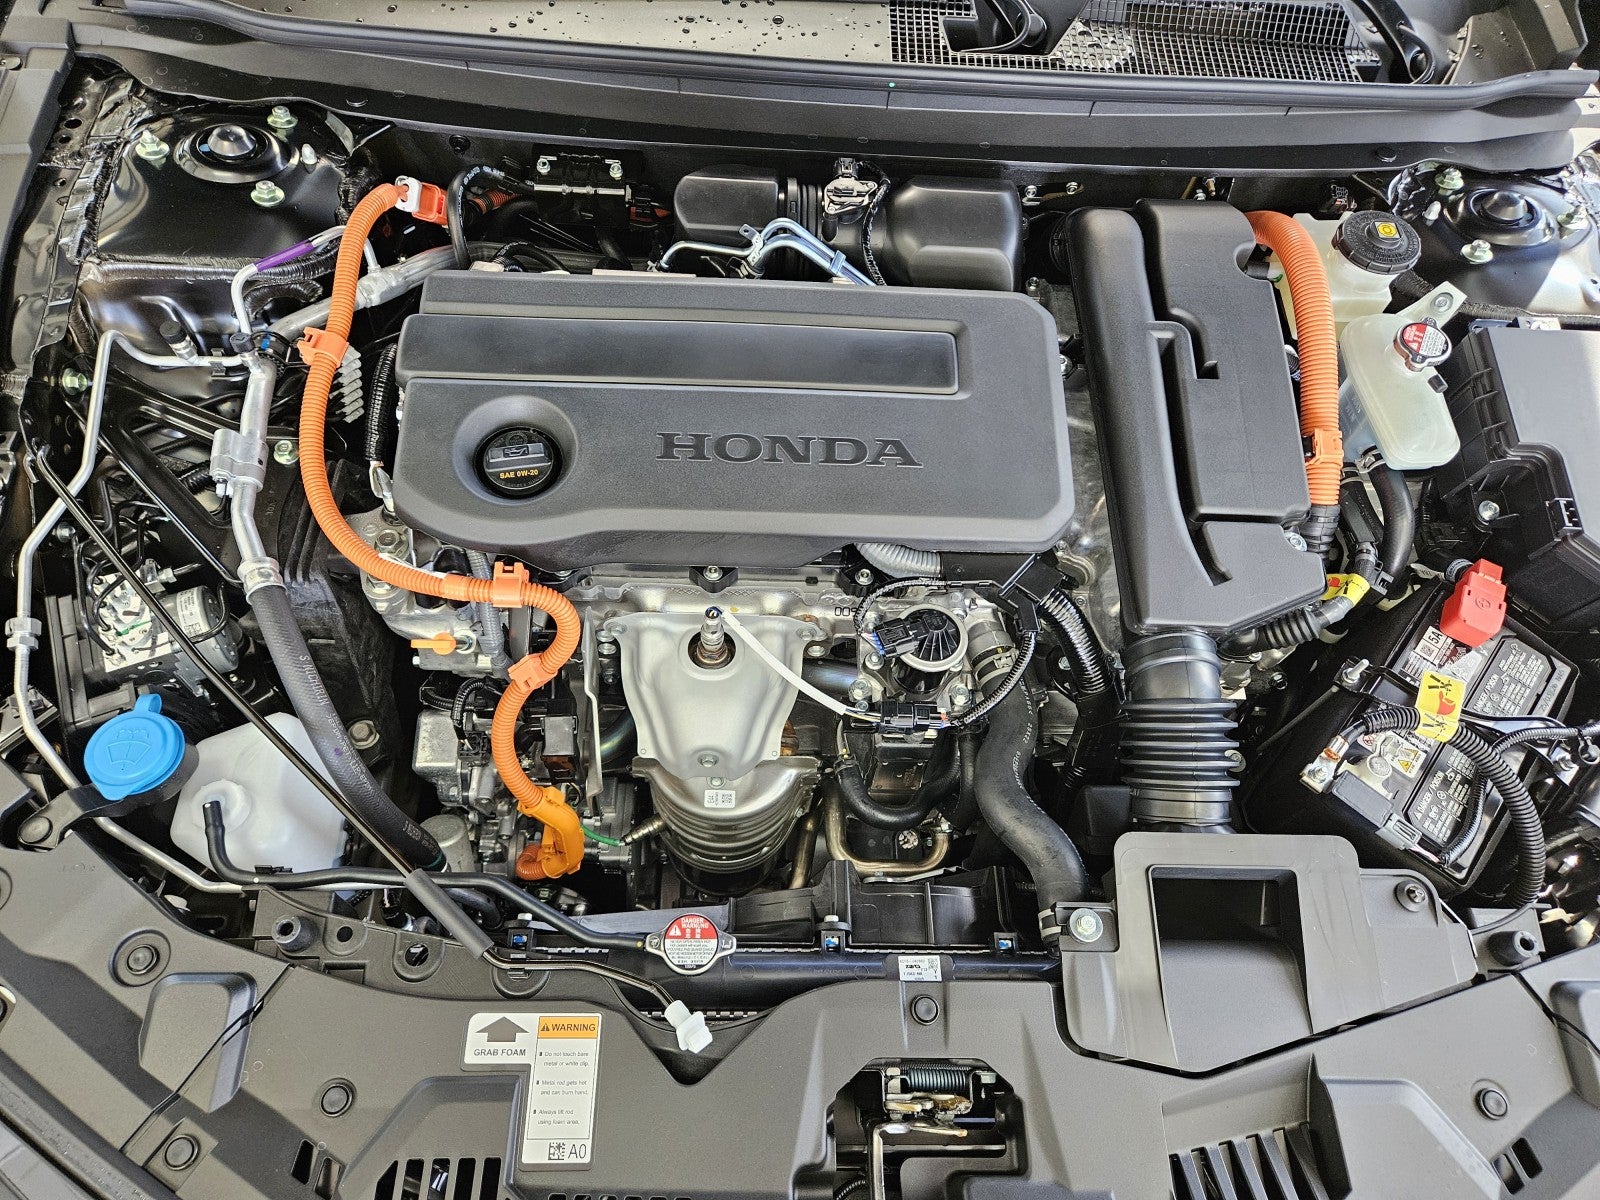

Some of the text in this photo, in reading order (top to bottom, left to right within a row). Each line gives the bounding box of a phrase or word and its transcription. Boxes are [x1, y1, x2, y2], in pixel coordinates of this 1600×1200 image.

[655, 431, 923, 468] HONDA
[500, 469, 539, 479] SAE 0W-20
[1428, 630, 1442, 645] 5A
[551, 1023, 596, 1032] WARNING
[473, 1048, 526, 1056] GRAB FOAM
[568, 1144, 587, 1159] A0
